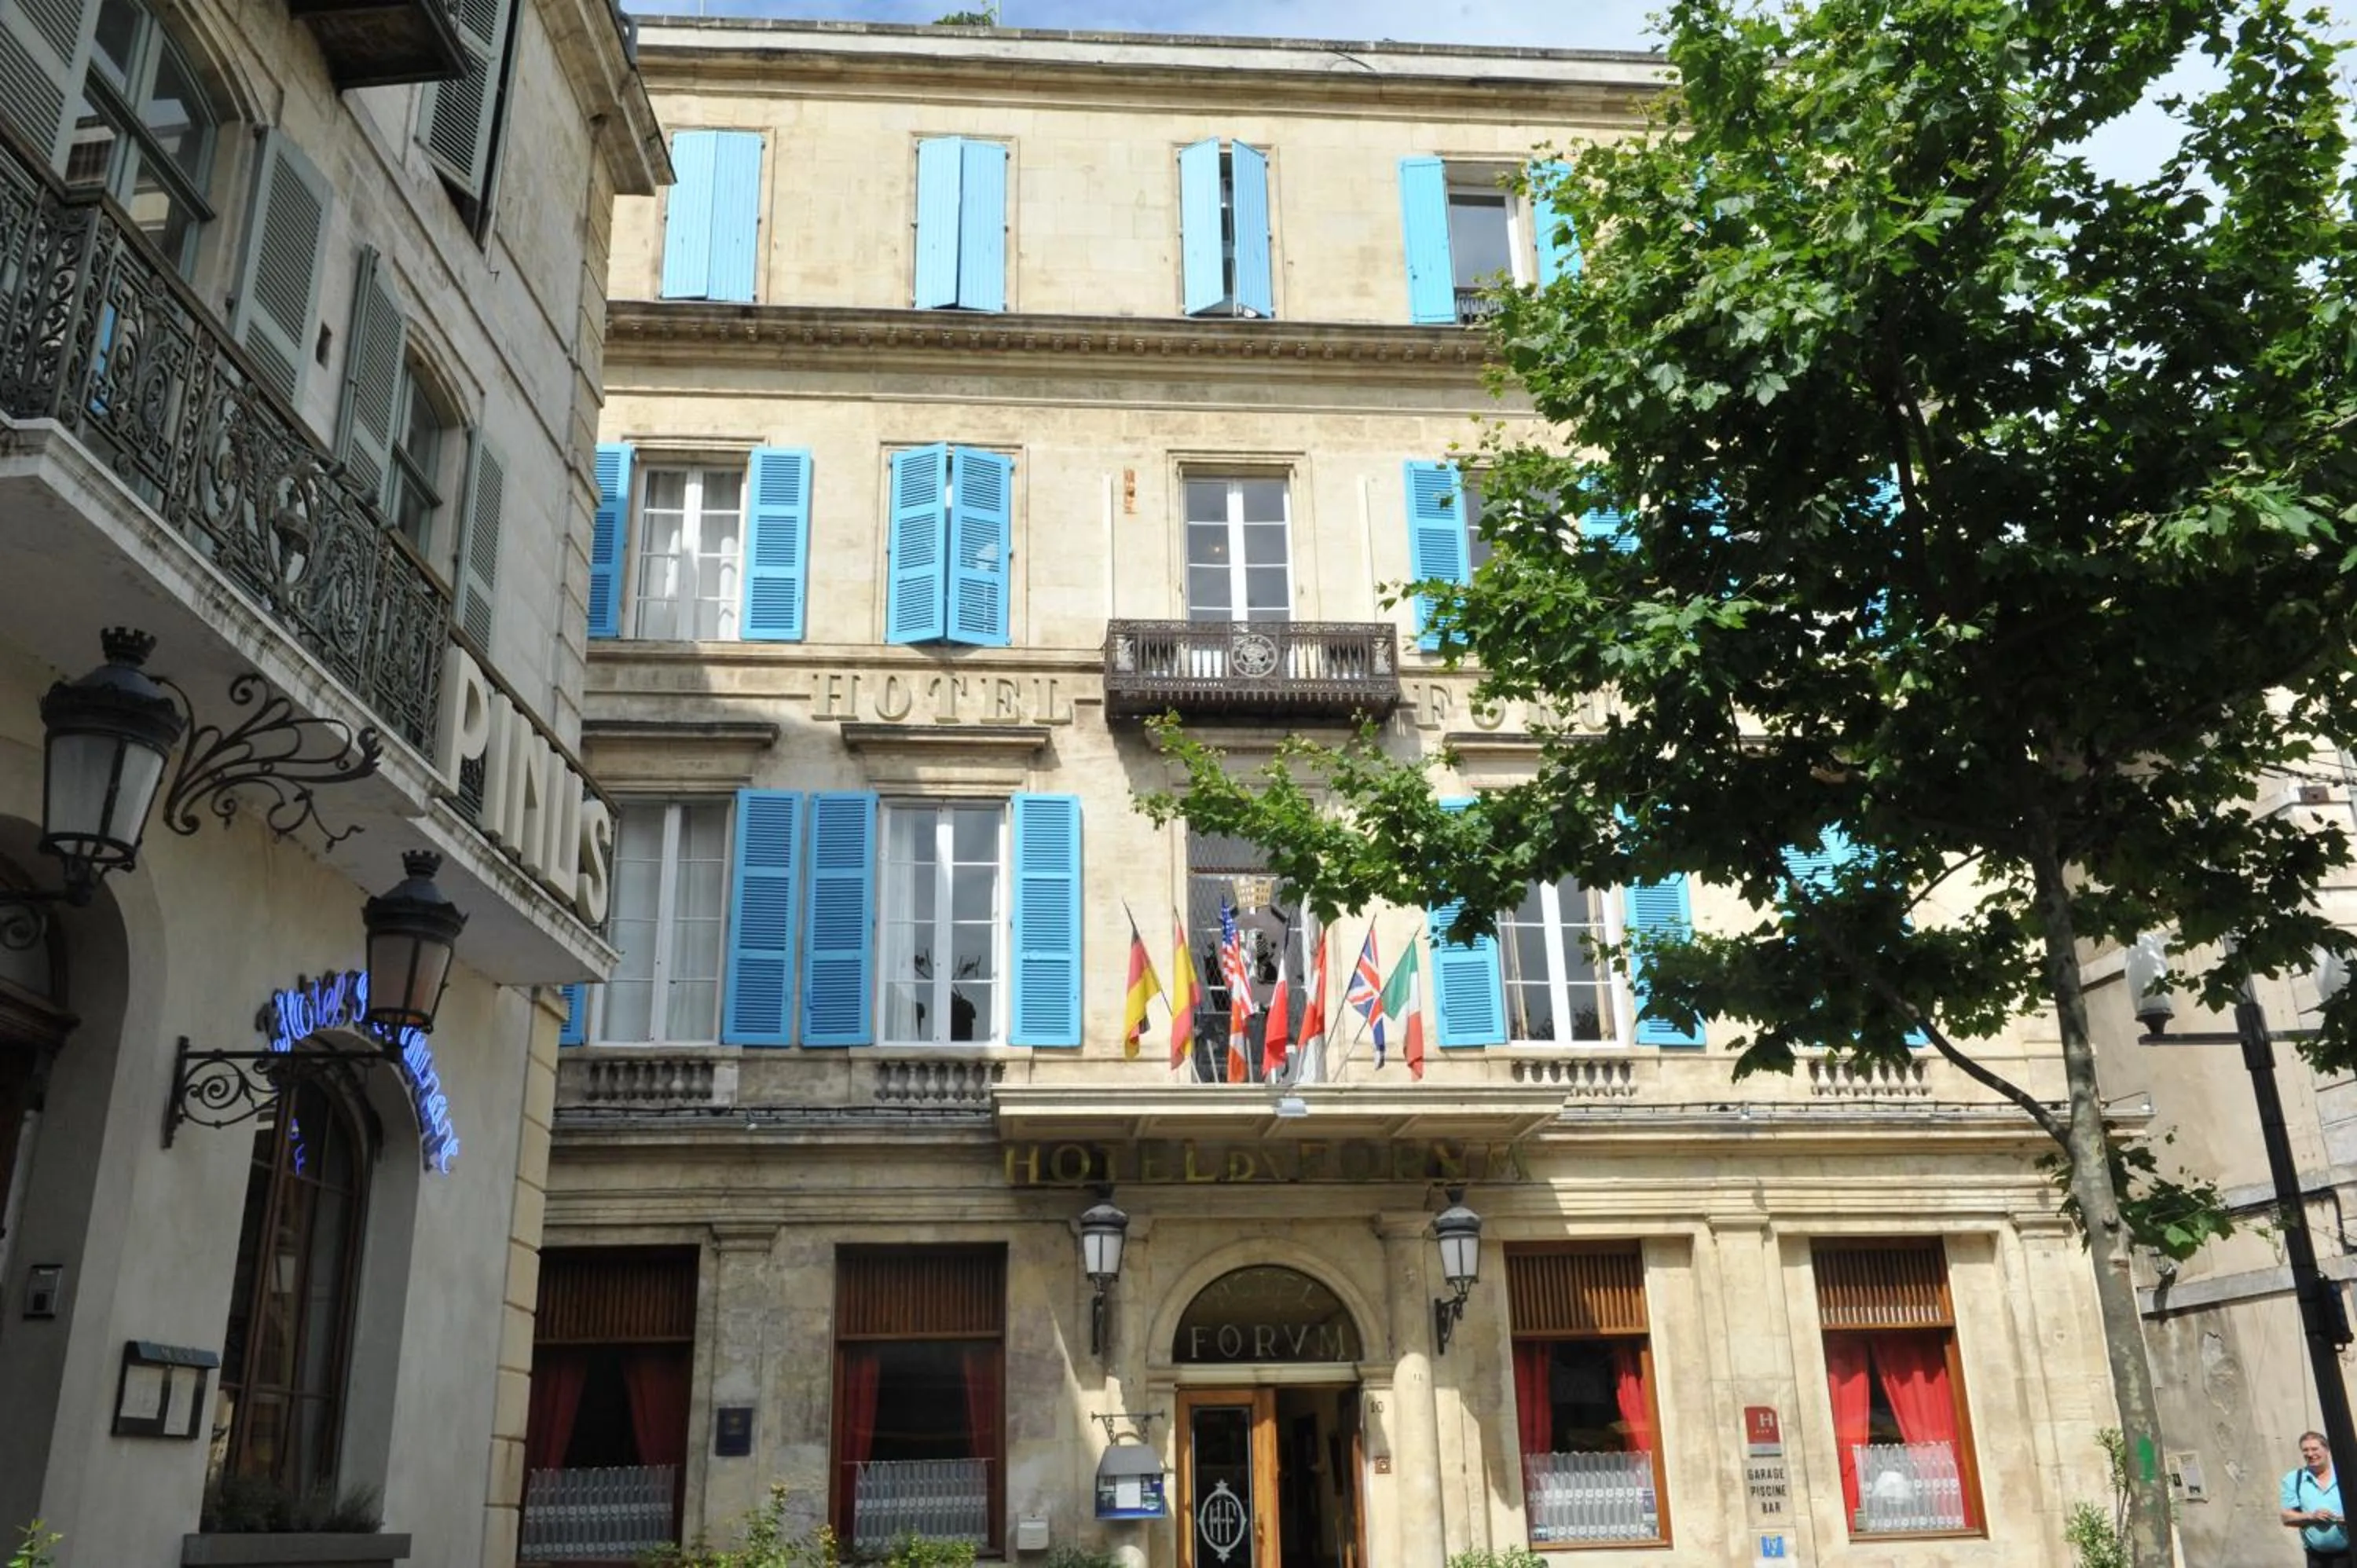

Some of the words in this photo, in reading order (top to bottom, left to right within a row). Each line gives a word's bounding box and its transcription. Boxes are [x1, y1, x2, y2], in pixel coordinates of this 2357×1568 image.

[812, 672, 1072, 724] HOTEL
[435, 646, 611, 922] PINUS
[1005, 1141, 1216, 1183] HOTEL
[1191, 1324, 1346, 1361] FORVM
[1759, 1413, 1774, 1427] H
[1747, 1468, 1785, 1481] GARAGE
[1750, 1486, 1787, 1497] PISCINE
[1761, 1501, 1782, 1515] BAR
